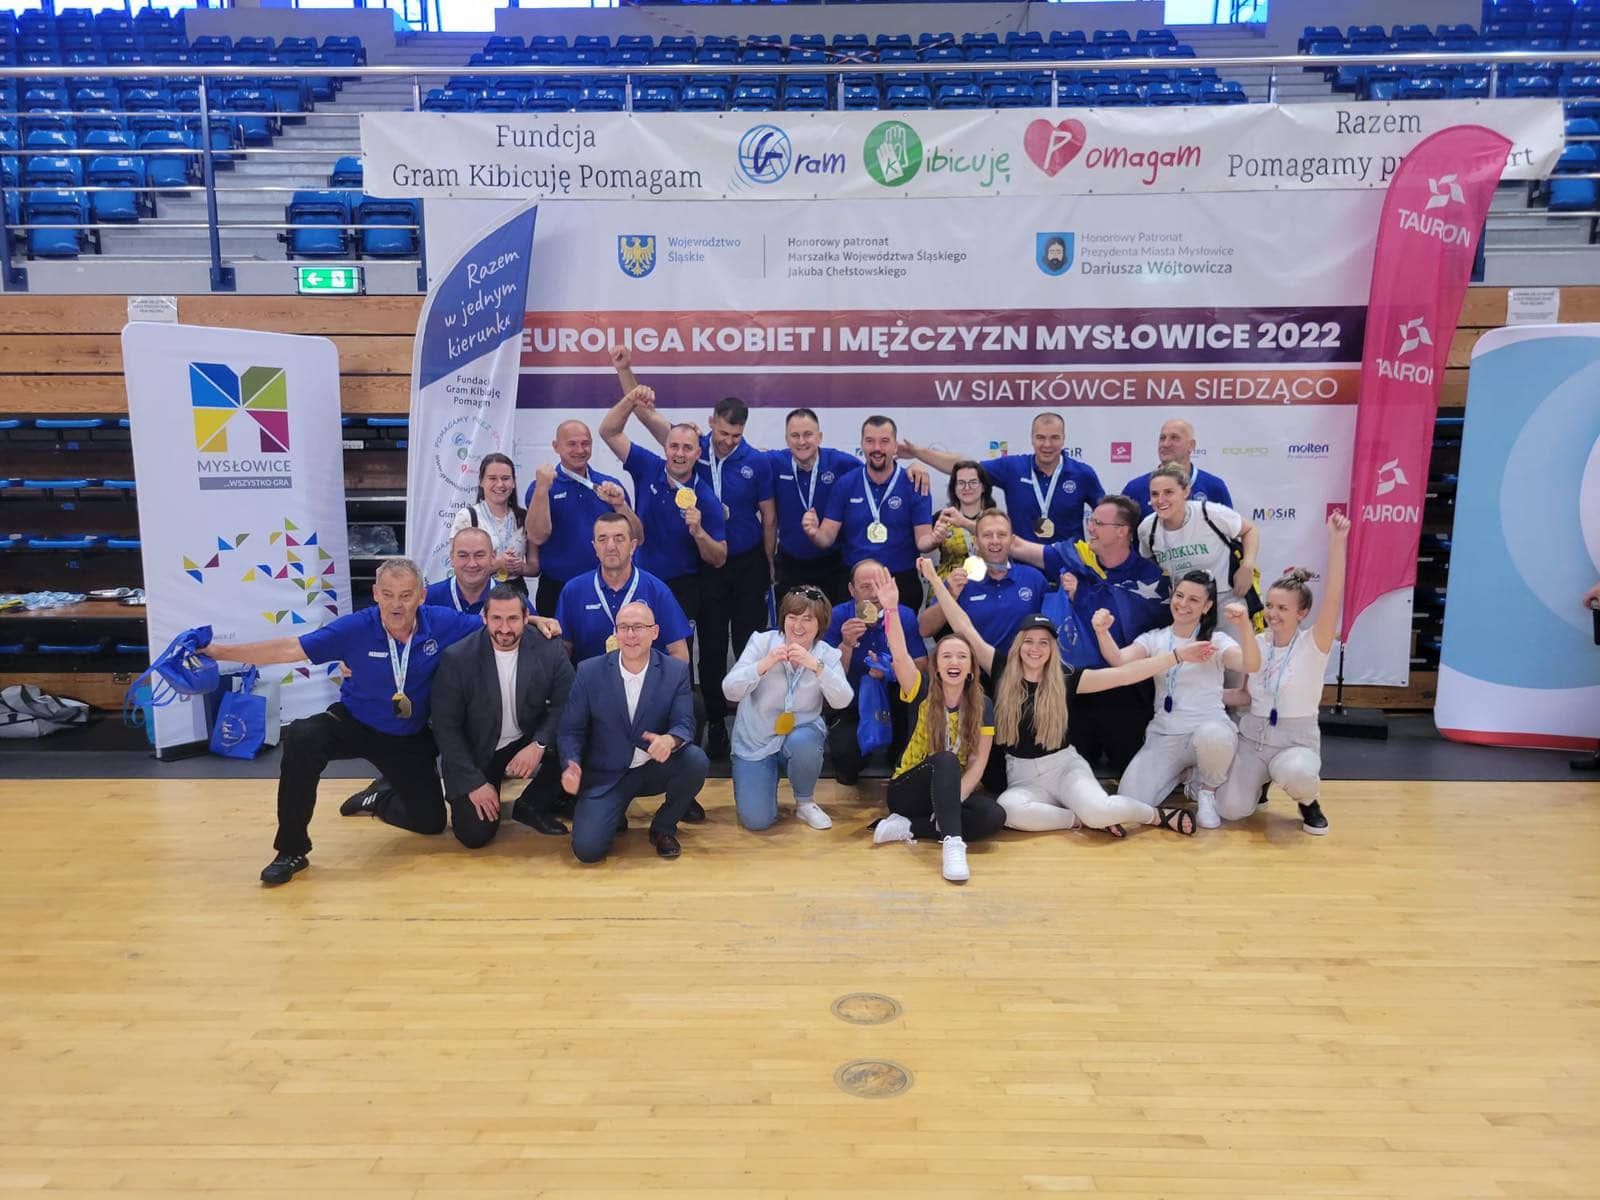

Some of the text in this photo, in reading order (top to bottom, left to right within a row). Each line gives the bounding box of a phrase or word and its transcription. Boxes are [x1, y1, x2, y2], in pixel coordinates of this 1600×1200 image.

[1336, 110, 1422, 135] Razem
[496, 124, 596, 155] Fundcja
[1228, 153, 1381, 184] Pomagamy
[393, 163, 702, 195] Gram Kibicuję Pomagam
[1081, 231, 1183, 244] Honorowy Patronat
[1397, 208, 1472, 249] TAURON
[788, 236, 889, 250] Honorowy patronat
[668, 250, 705, 264] Śląskie
[788, 248, 967, 264] Marszałka Województwa Śląskiego
[1080, 246, 1139, 260] Prezydenta
[1140, 246, 1176, 258] Miasta
[467, 251, 520, 289] Razem
[788, 264, 907, 280] Jakuba Chełstowskiego
[1081, 259, 1233, 277] Dariusza Wójtowicza
[444, 282, 517, 328] w jednym
[520, 319, 1341, 359] EUROLIGA KOBIET I MĘŻCZYZN MYSŁOWICE 2022
[934, 373, 1339, 404] W SIATKÓWCE NA SIEDZĄCO
[1063, 446, 1082, 459] SiR
[1288, 443, 1329, 454] molten
[196, 459, 293, 473] MYSŁOWICE
[273, 478, 290, 487] GRA
[1362, 503, 1420, 523] AURON
